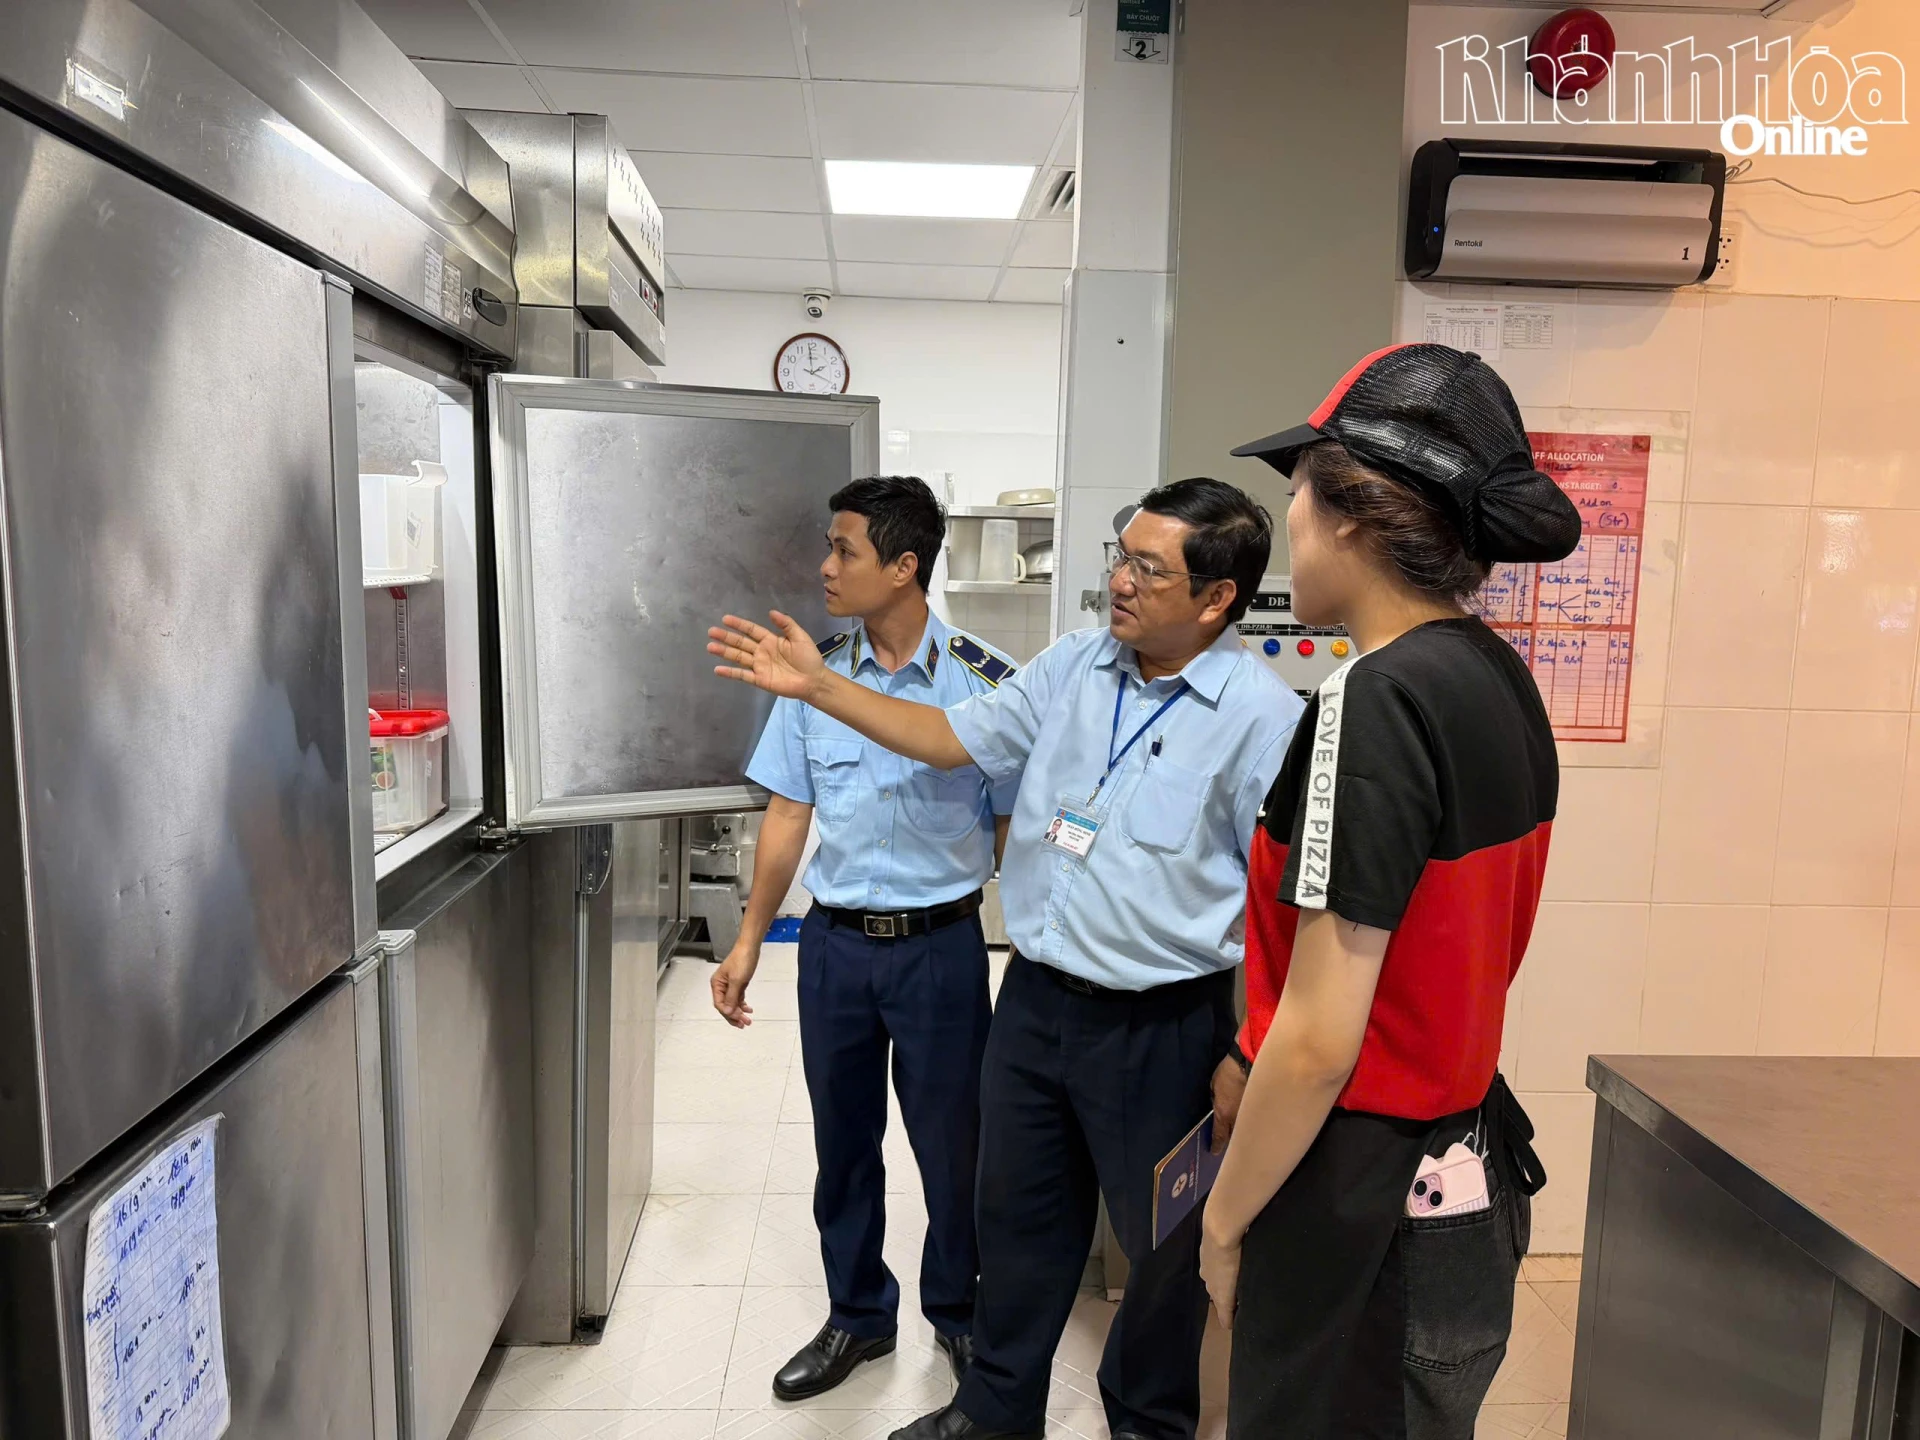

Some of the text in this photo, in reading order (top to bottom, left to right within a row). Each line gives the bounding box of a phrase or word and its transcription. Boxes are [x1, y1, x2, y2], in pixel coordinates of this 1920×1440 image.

[1135, 40, 1146, 58] 2
[1454, 239, 1483, 247] Rentokil
[1681, 247, 1690, 261] 1
[787, 355, 796, 364] 10
[830, 356, 838, 365] 2
[782, 368, 790, 377] 9
[834, 370, 842, 378] 3
[786, 381, 794, 390] 8
[1547, 453, 1604, 461] ALLOCATION
[1268, 596, 1291, 606] DB-
[1314, 691, 1339, 763] LOVE
[1312, 772, 1332, 810] OF
[1301, 819, 1329, 899] PIZZA
